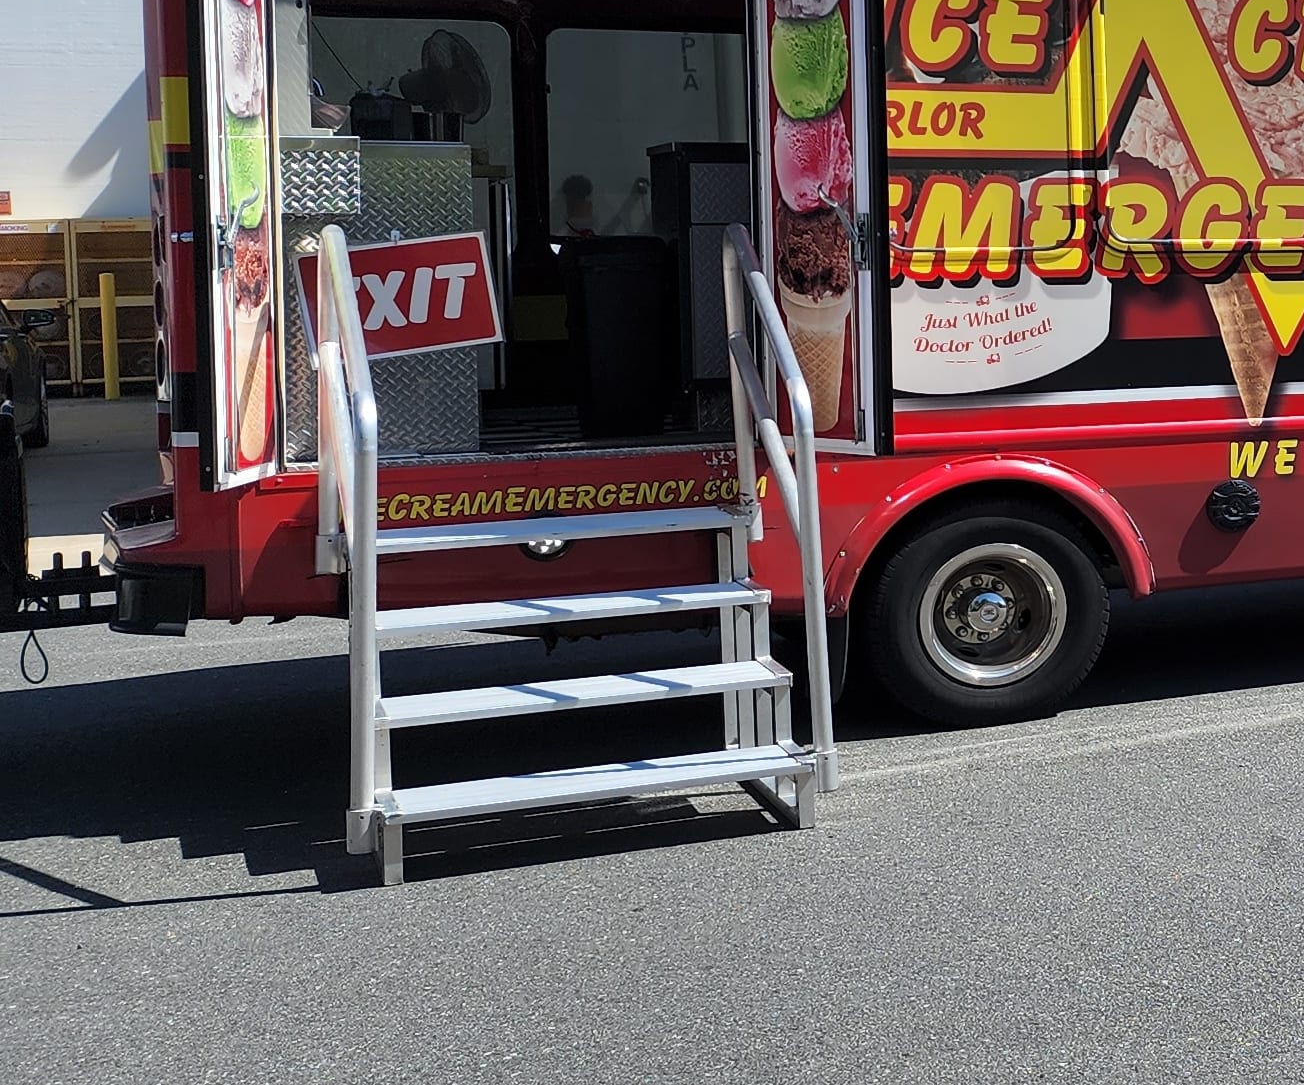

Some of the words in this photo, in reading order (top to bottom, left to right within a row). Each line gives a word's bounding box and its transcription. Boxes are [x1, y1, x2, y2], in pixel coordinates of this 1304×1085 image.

[352, 262, 477, 331] XIT
[913, 336, 974, 353] Doctor
[978, 317, 1053, 351] Ordered!
[920, 313, 958, 333] Just
[963, 307, 1010, 328] What
[1014, 300, 1038, 319] the
[1229, 438, 1299, 479] WE
